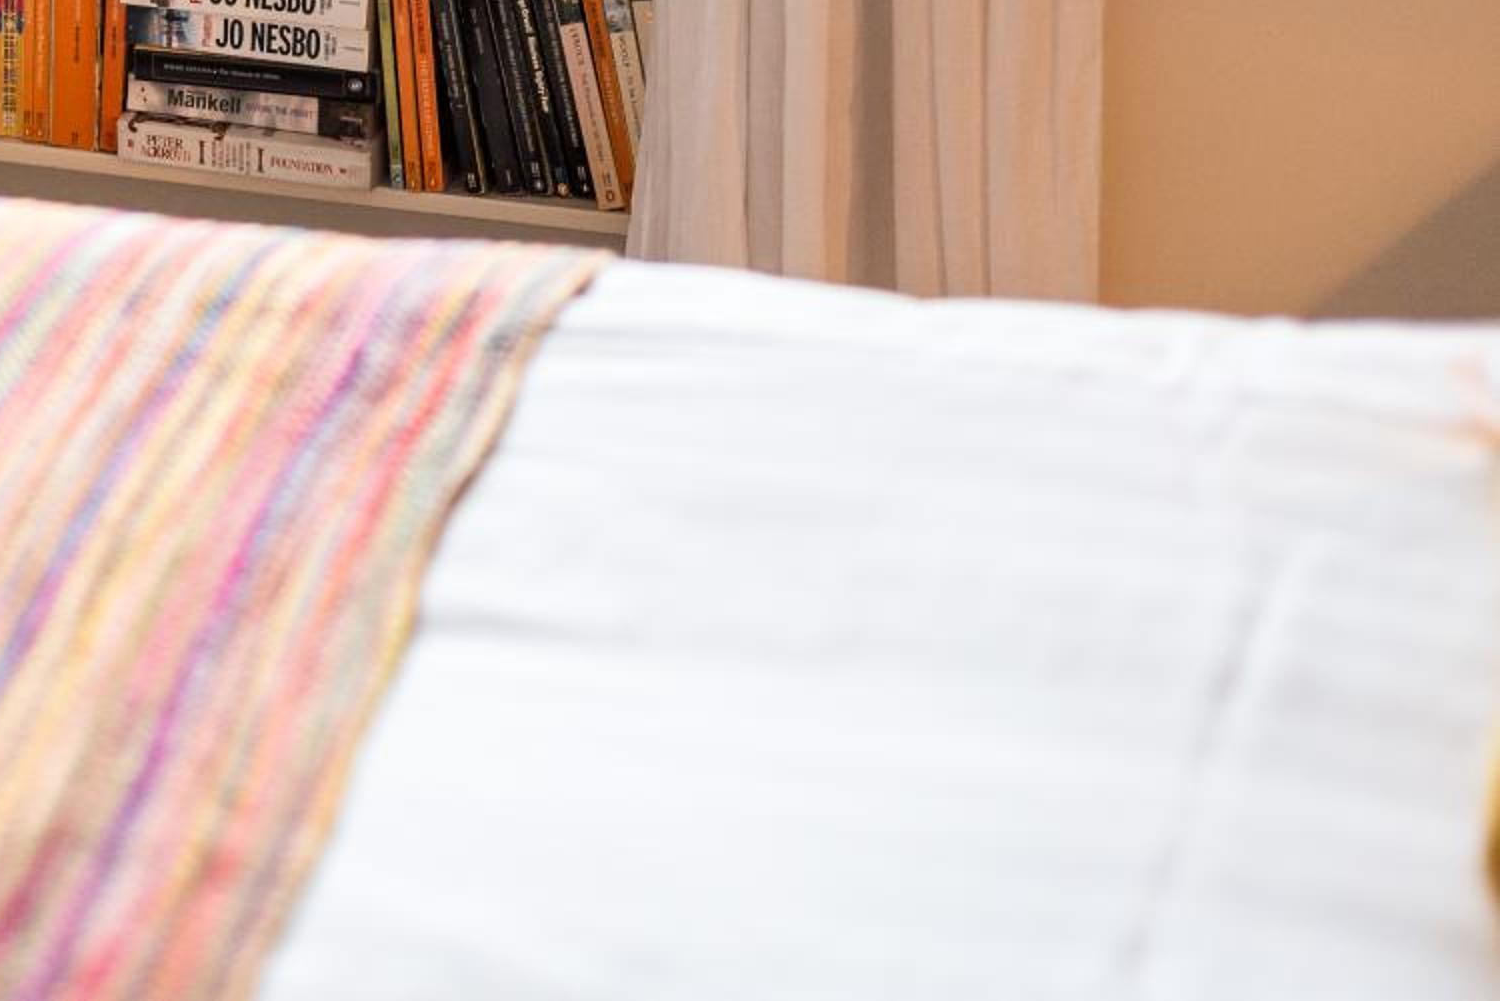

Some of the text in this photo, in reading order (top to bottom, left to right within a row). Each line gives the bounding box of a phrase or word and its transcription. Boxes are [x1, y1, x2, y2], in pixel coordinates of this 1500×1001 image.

[216, 18, 244, 50] JO
[251, 22, 321, 60] NESBO
[167, 88, 241, 114] Mankell
[146, 135, 183, 149] PETER
[270, 156, 333, 174] FOUNDATION
